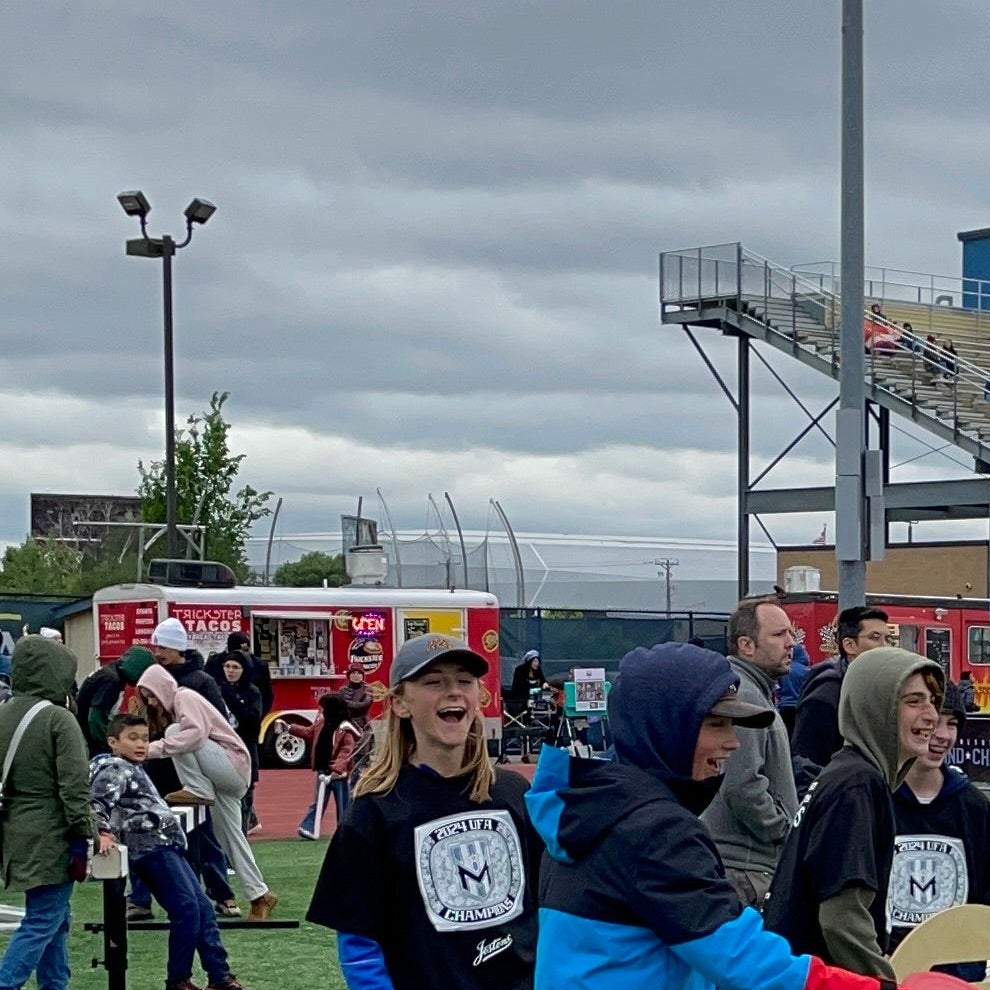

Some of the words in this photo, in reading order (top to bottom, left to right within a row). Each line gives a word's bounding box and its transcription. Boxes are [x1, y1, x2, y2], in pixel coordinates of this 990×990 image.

[104, 621, 125, 631] TACOS
[185, 620, 242, 632] TACOS
[435, 822, 468, 840] 2024
[469, 819, 493, 831] UFA
[457, 861, 492, 890] M
[910, 876, 936, 897] M
[444, 897, 514, 922] CHAMPIONS
